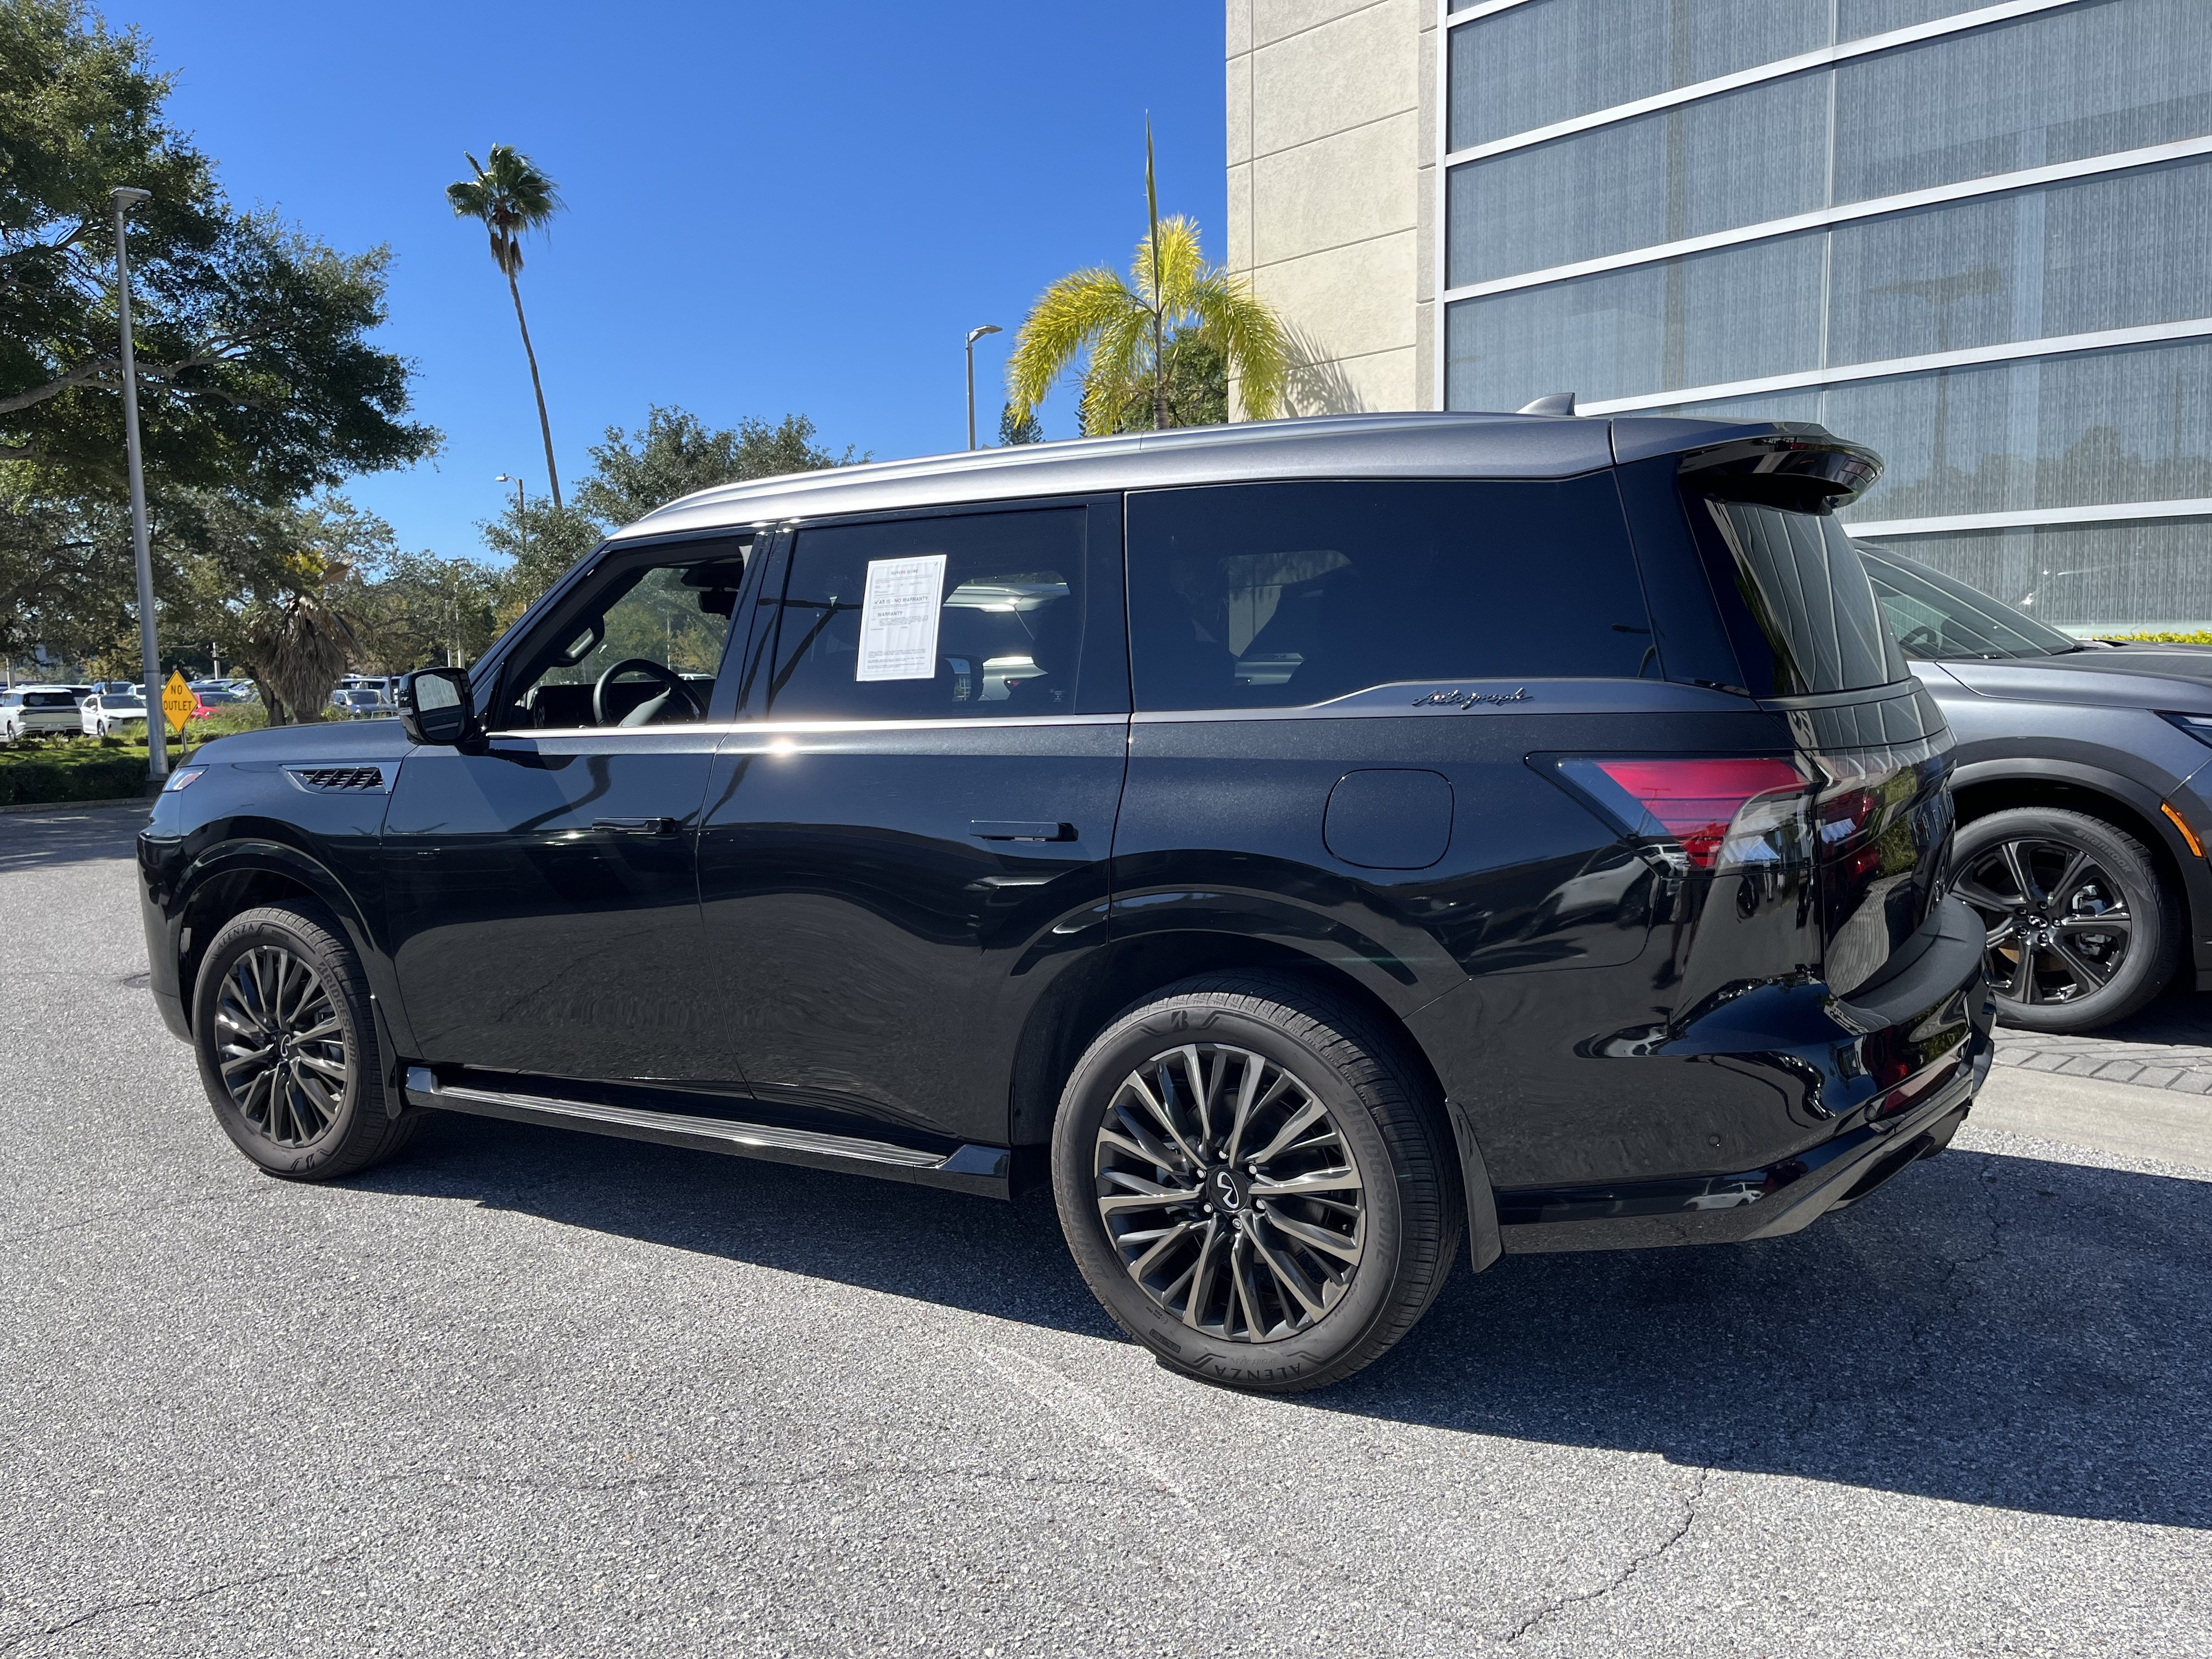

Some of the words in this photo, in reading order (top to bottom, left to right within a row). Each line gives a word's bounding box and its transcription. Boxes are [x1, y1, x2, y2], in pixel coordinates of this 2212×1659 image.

[171, 685, 182, 695] NO
[1411, 687, 1534, 710] Autograph
[163, 701, 192, 710] OUTLET
[217, 923, 254, 950] ALENZA
[316, 961, 357, 1067] BRIDGESTONE
[1339, 1099, 1396, 1268] BRIDGESTONE
[1214, 1363, 1301, 1381] ALENZA
